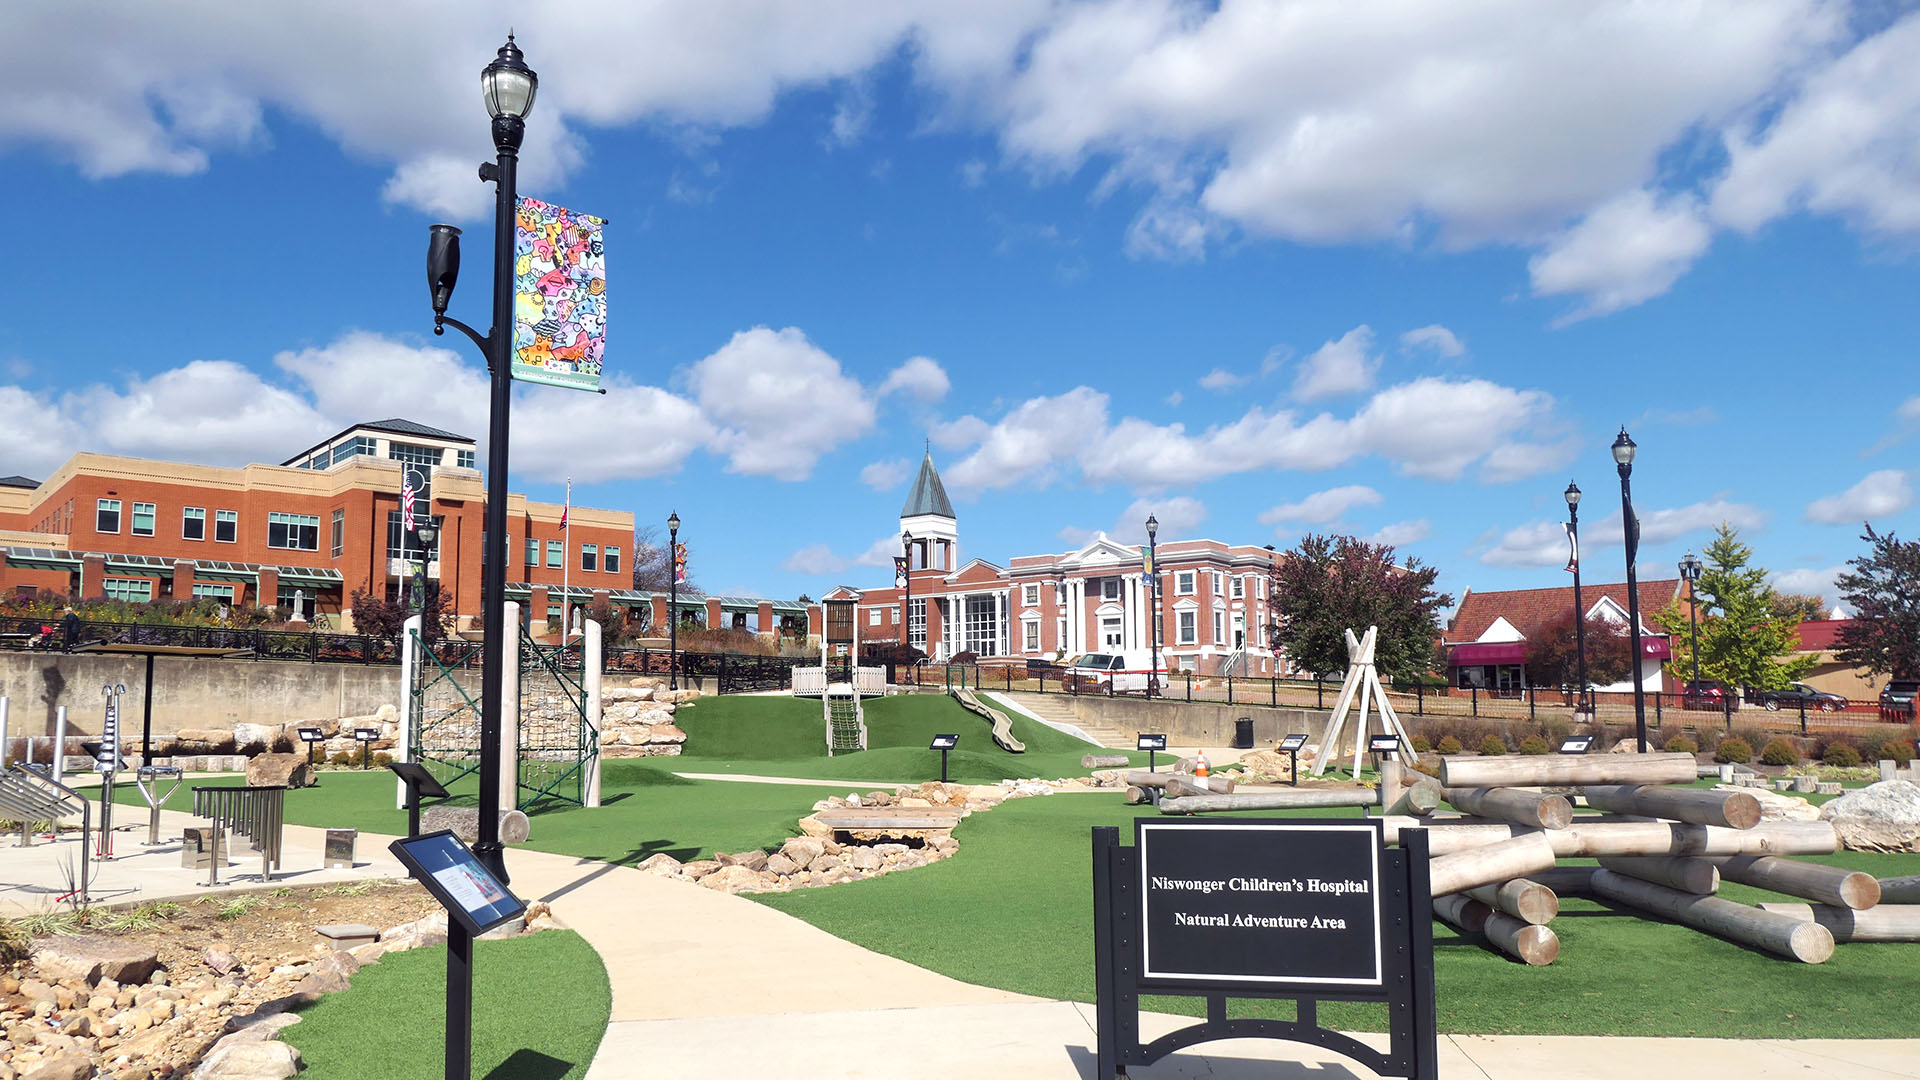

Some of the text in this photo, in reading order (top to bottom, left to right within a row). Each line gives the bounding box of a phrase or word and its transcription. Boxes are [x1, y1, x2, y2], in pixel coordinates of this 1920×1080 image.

[1151, 876, 1369, 896] Niswonger Children's Hospital
[1174, 912, 1346, 930] Natural Adventure Area
